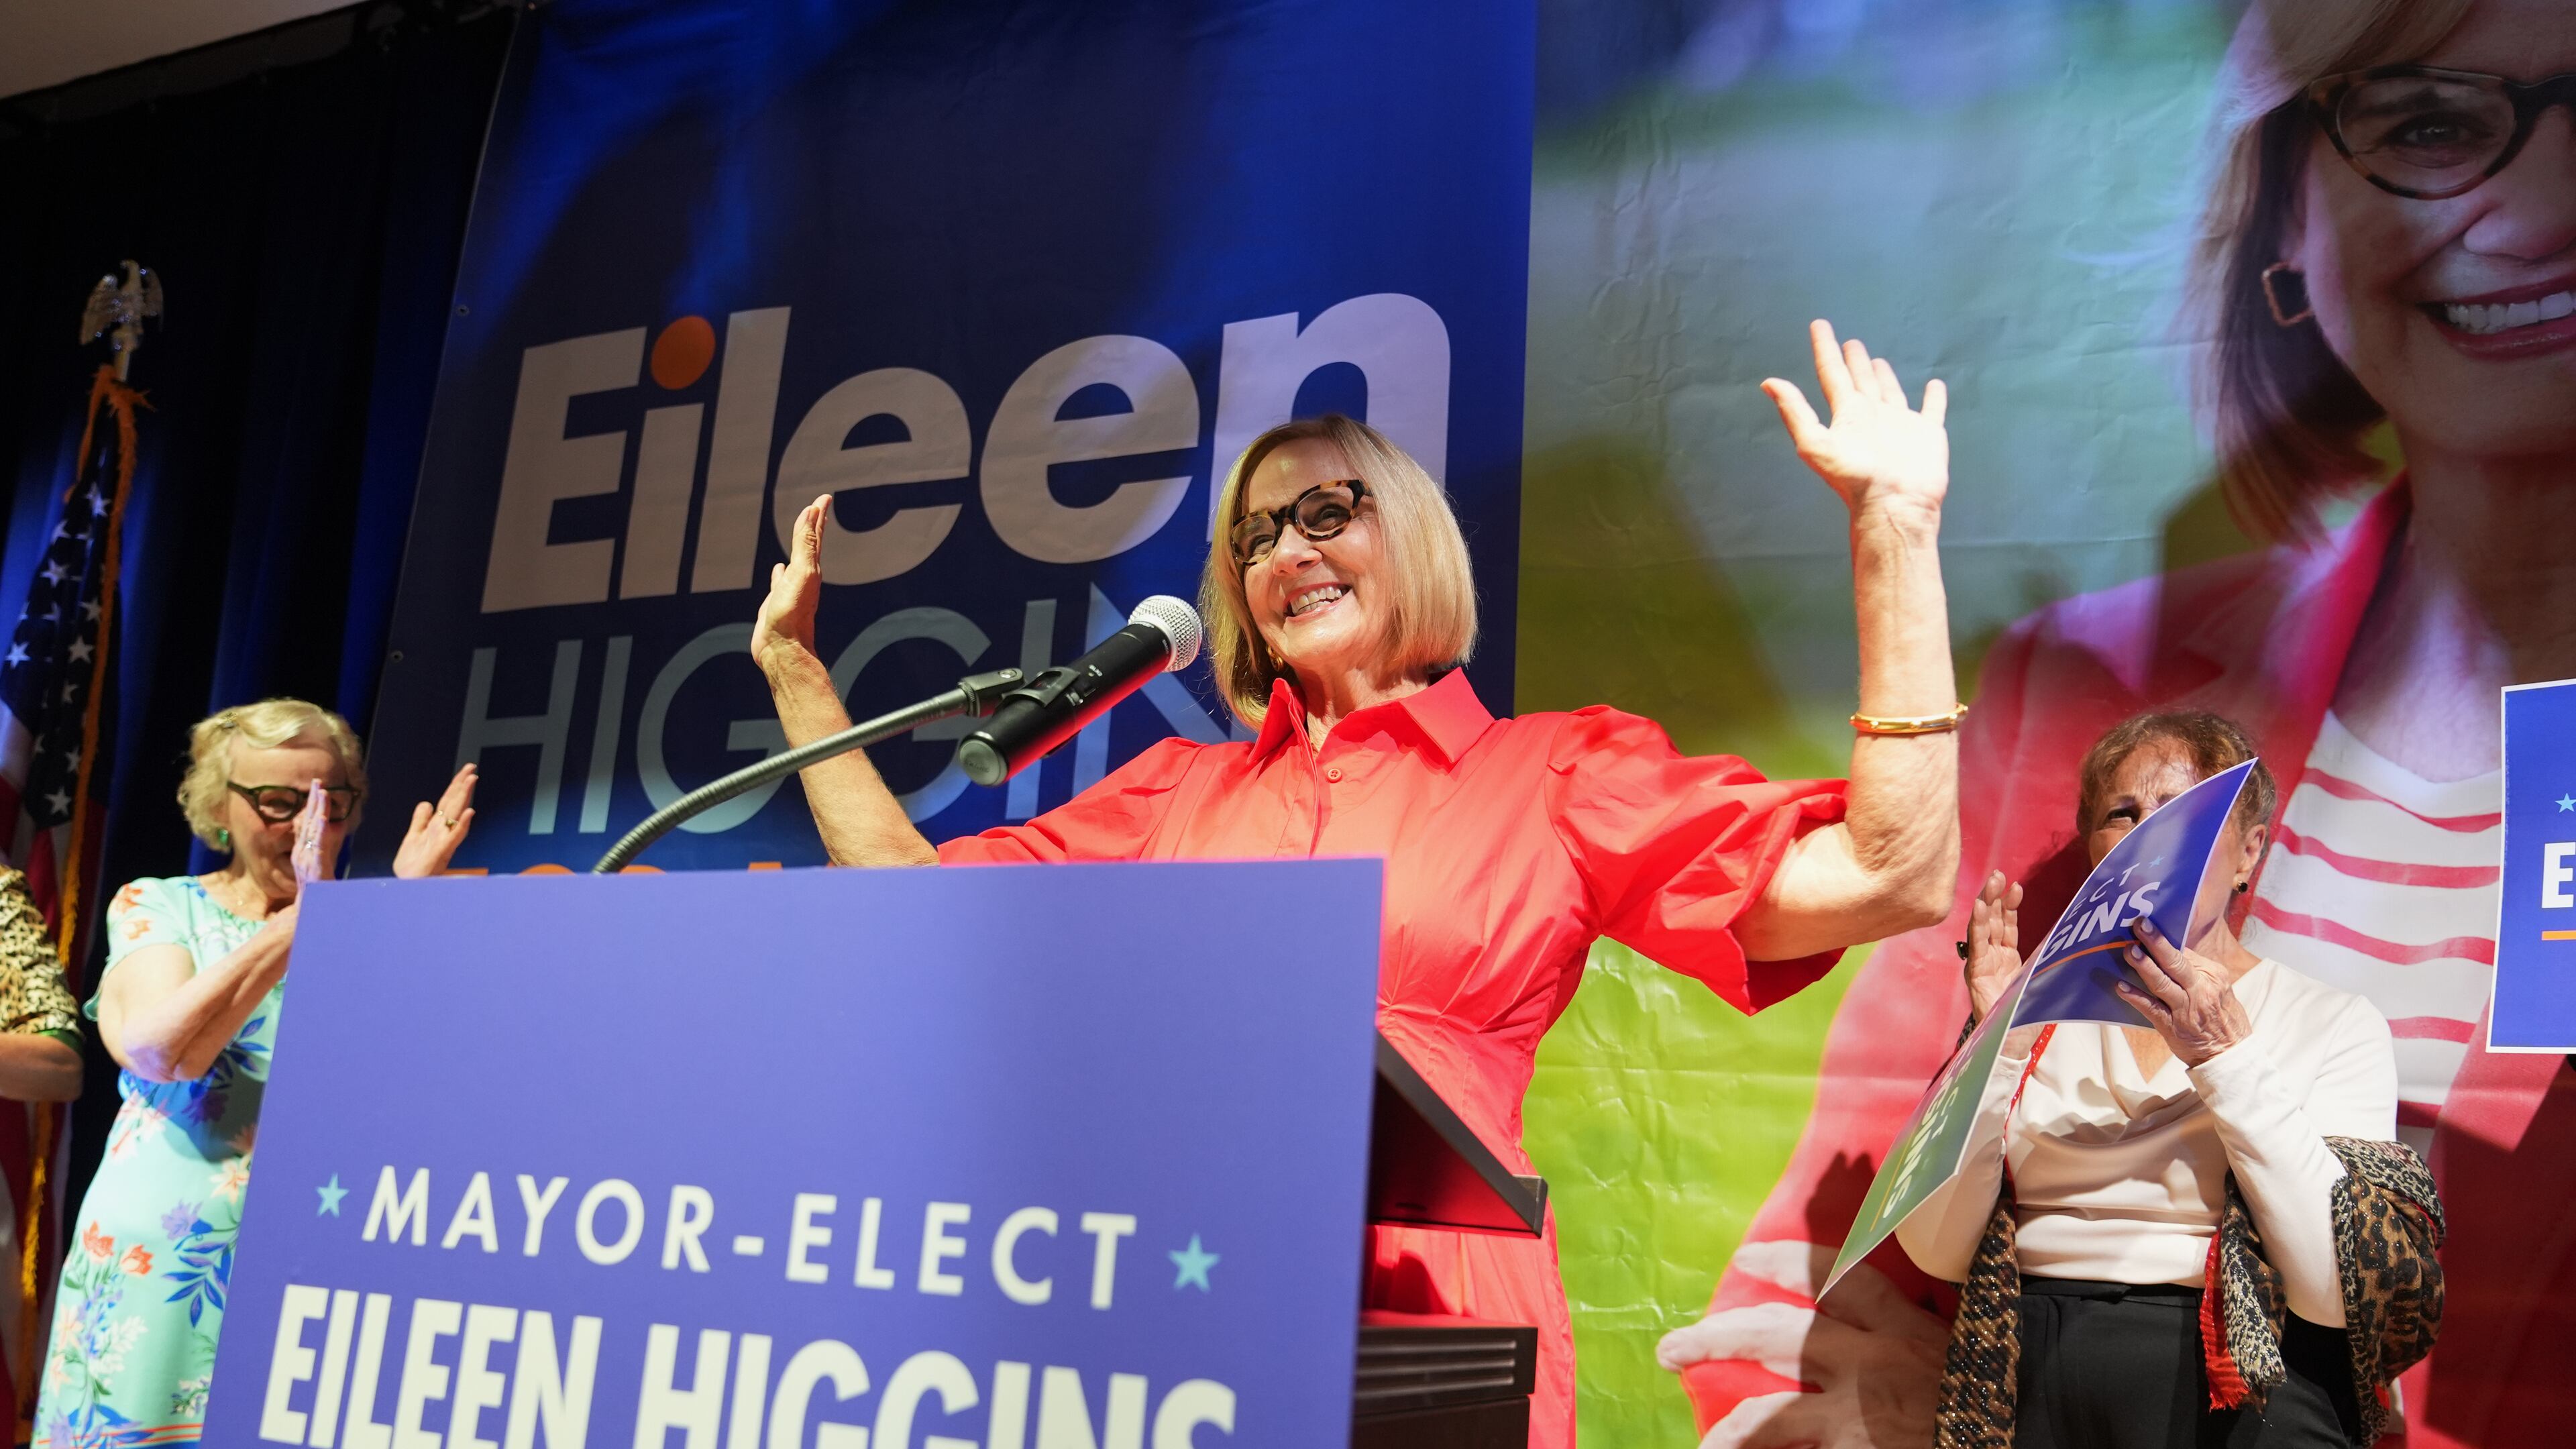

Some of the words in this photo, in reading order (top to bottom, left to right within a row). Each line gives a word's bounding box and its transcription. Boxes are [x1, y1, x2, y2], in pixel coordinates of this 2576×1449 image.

[480, 292, 1450, 614] Eileen
[454, 582, 1248, 835] HIGGI
[362, 1165, 1137, 1311] MAYOR-ELECT
[259, 1283, 603, 1449] EILEEN
